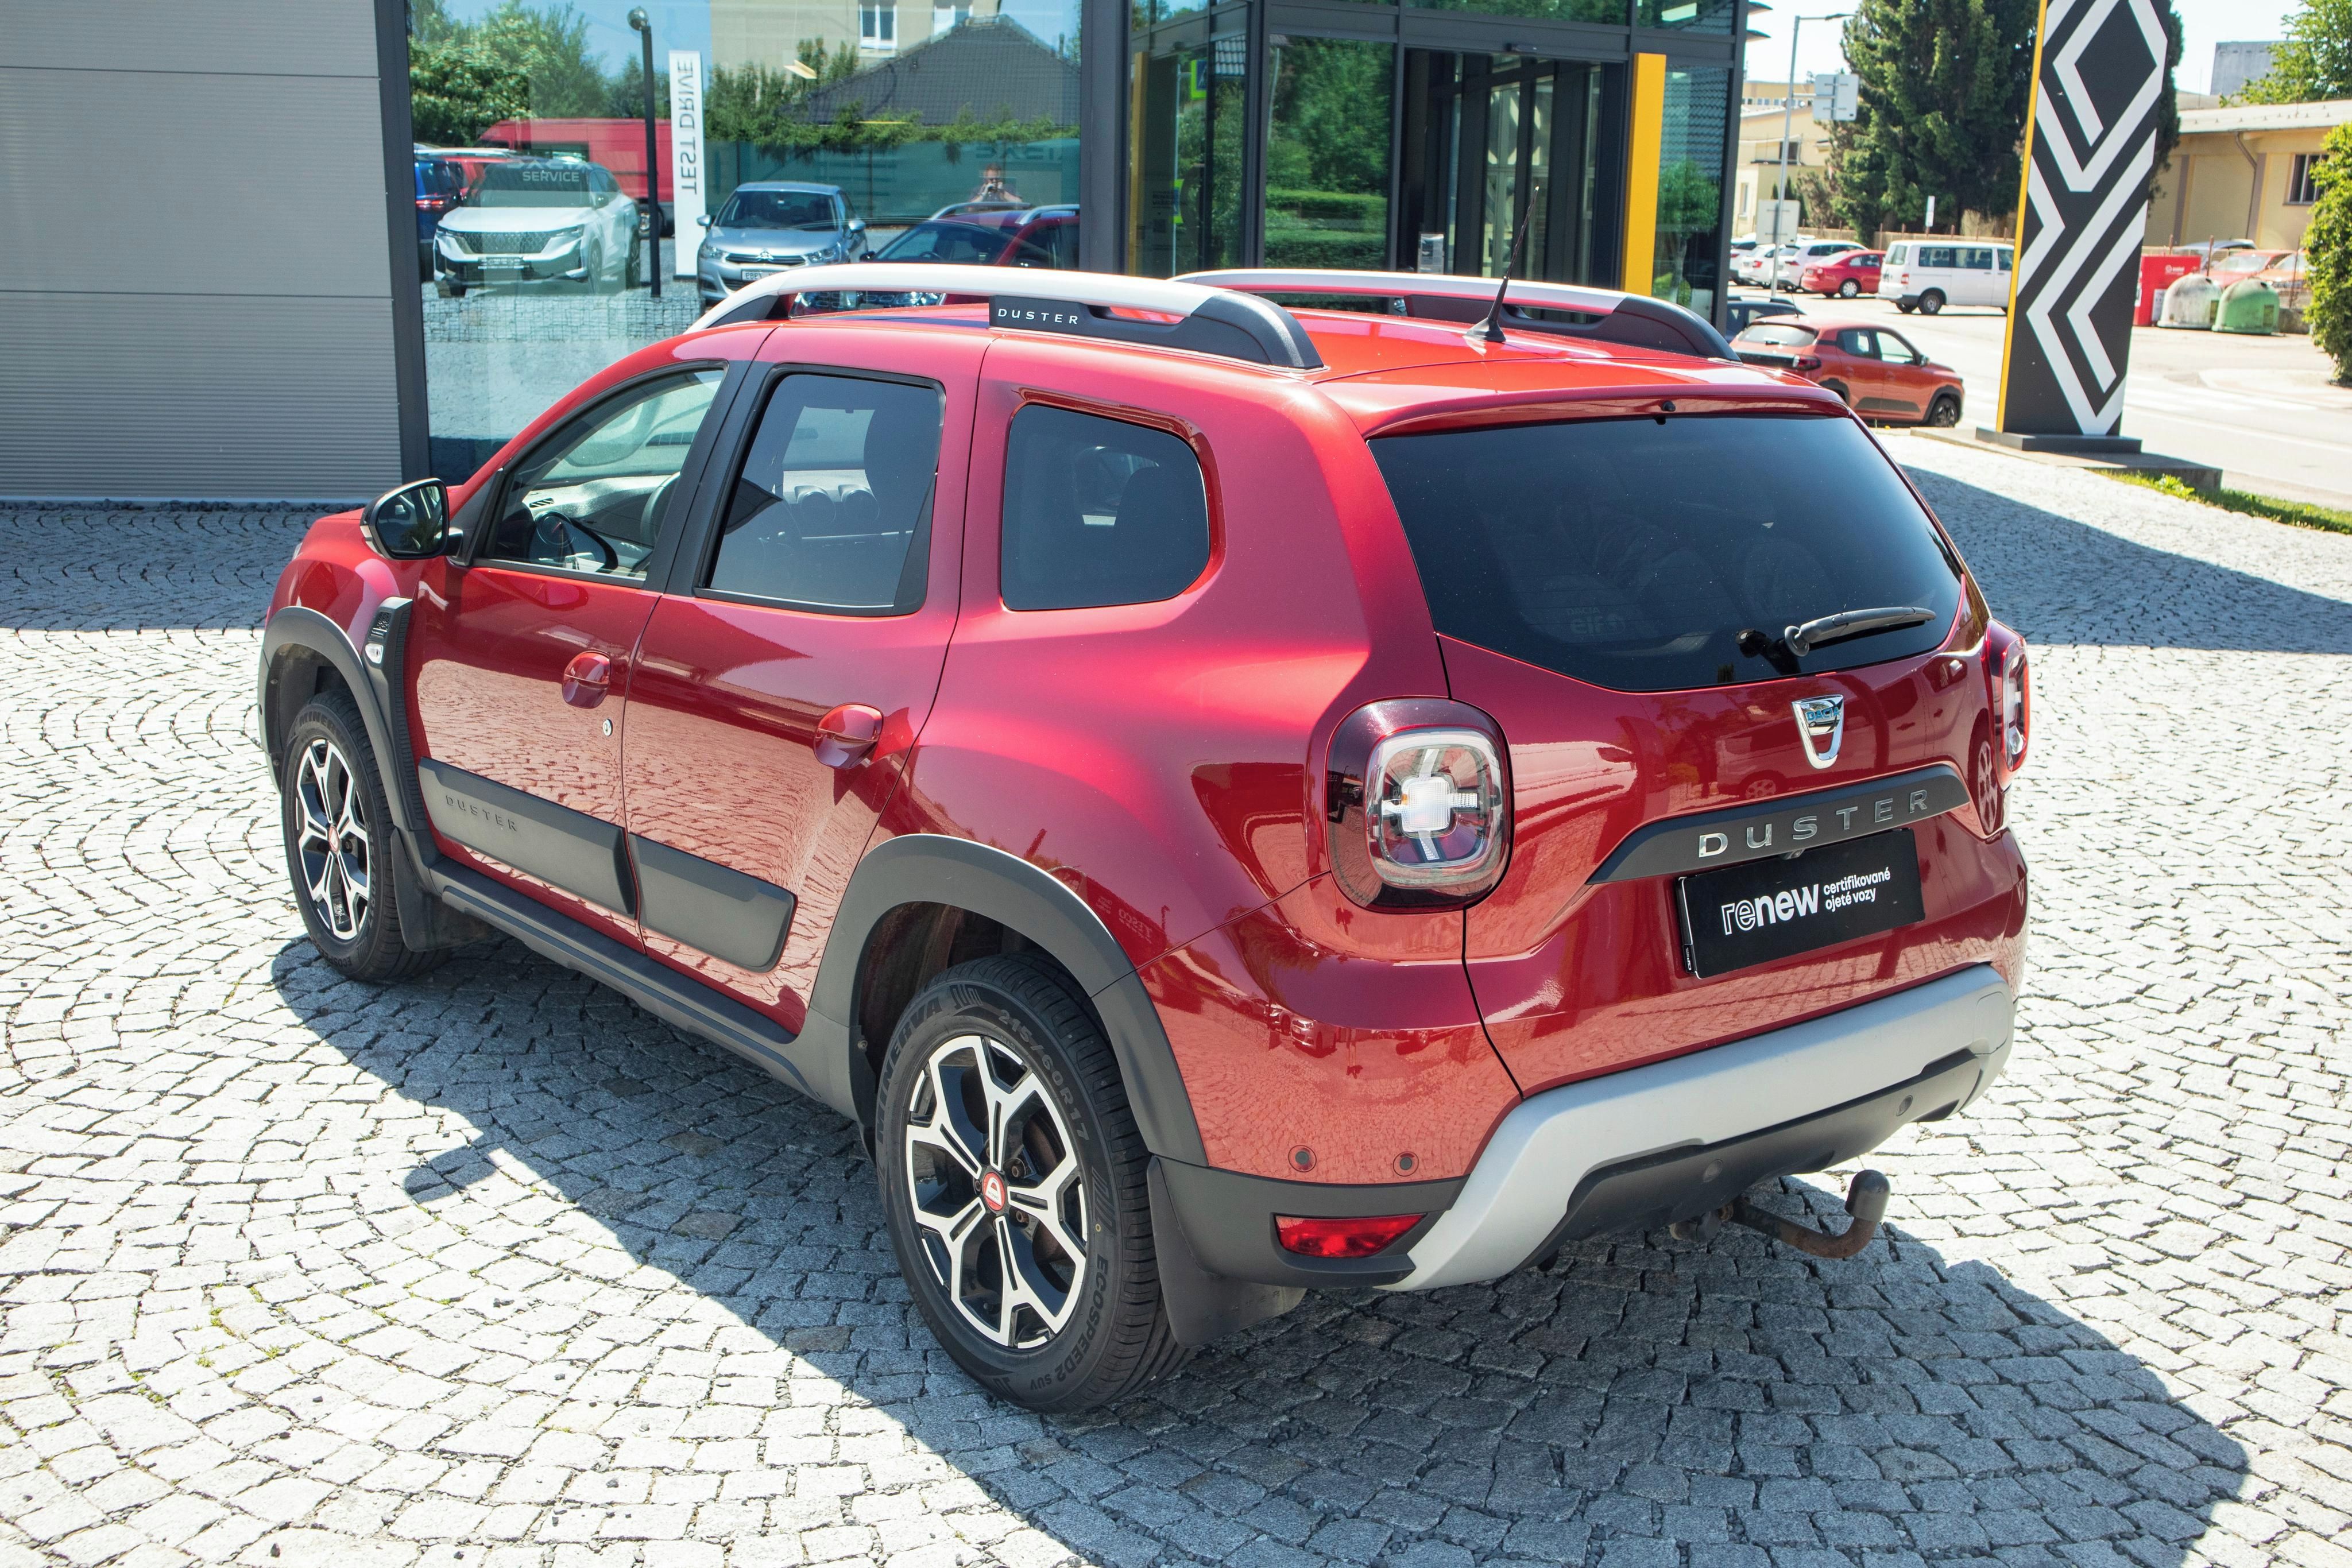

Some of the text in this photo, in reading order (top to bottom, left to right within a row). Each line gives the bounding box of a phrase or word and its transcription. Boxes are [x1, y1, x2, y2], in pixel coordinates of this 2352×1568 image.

[974, 147, 1062, 160] DACI
[523, 171, 579, 182] SERVICE
[998, 308, 1078, 324] DUSTER
[1805, 707, 1840, 721] DACIA
[446, 795, 517, 832] DUSTER
[1699, 789, 1928, 858] DUSTER
[1823, 866, 1891, 896] certifikované
[1721, 884, 1819, 935] renew
[1825, 888, 1877, 912] ojeté vozy
[876, 996, 943, 1144] MINERVA
[998, 1009, 1089, 1140] 215/60R17
[1030, 1253, 1108, 1391] ECOSPEED2 SUV
